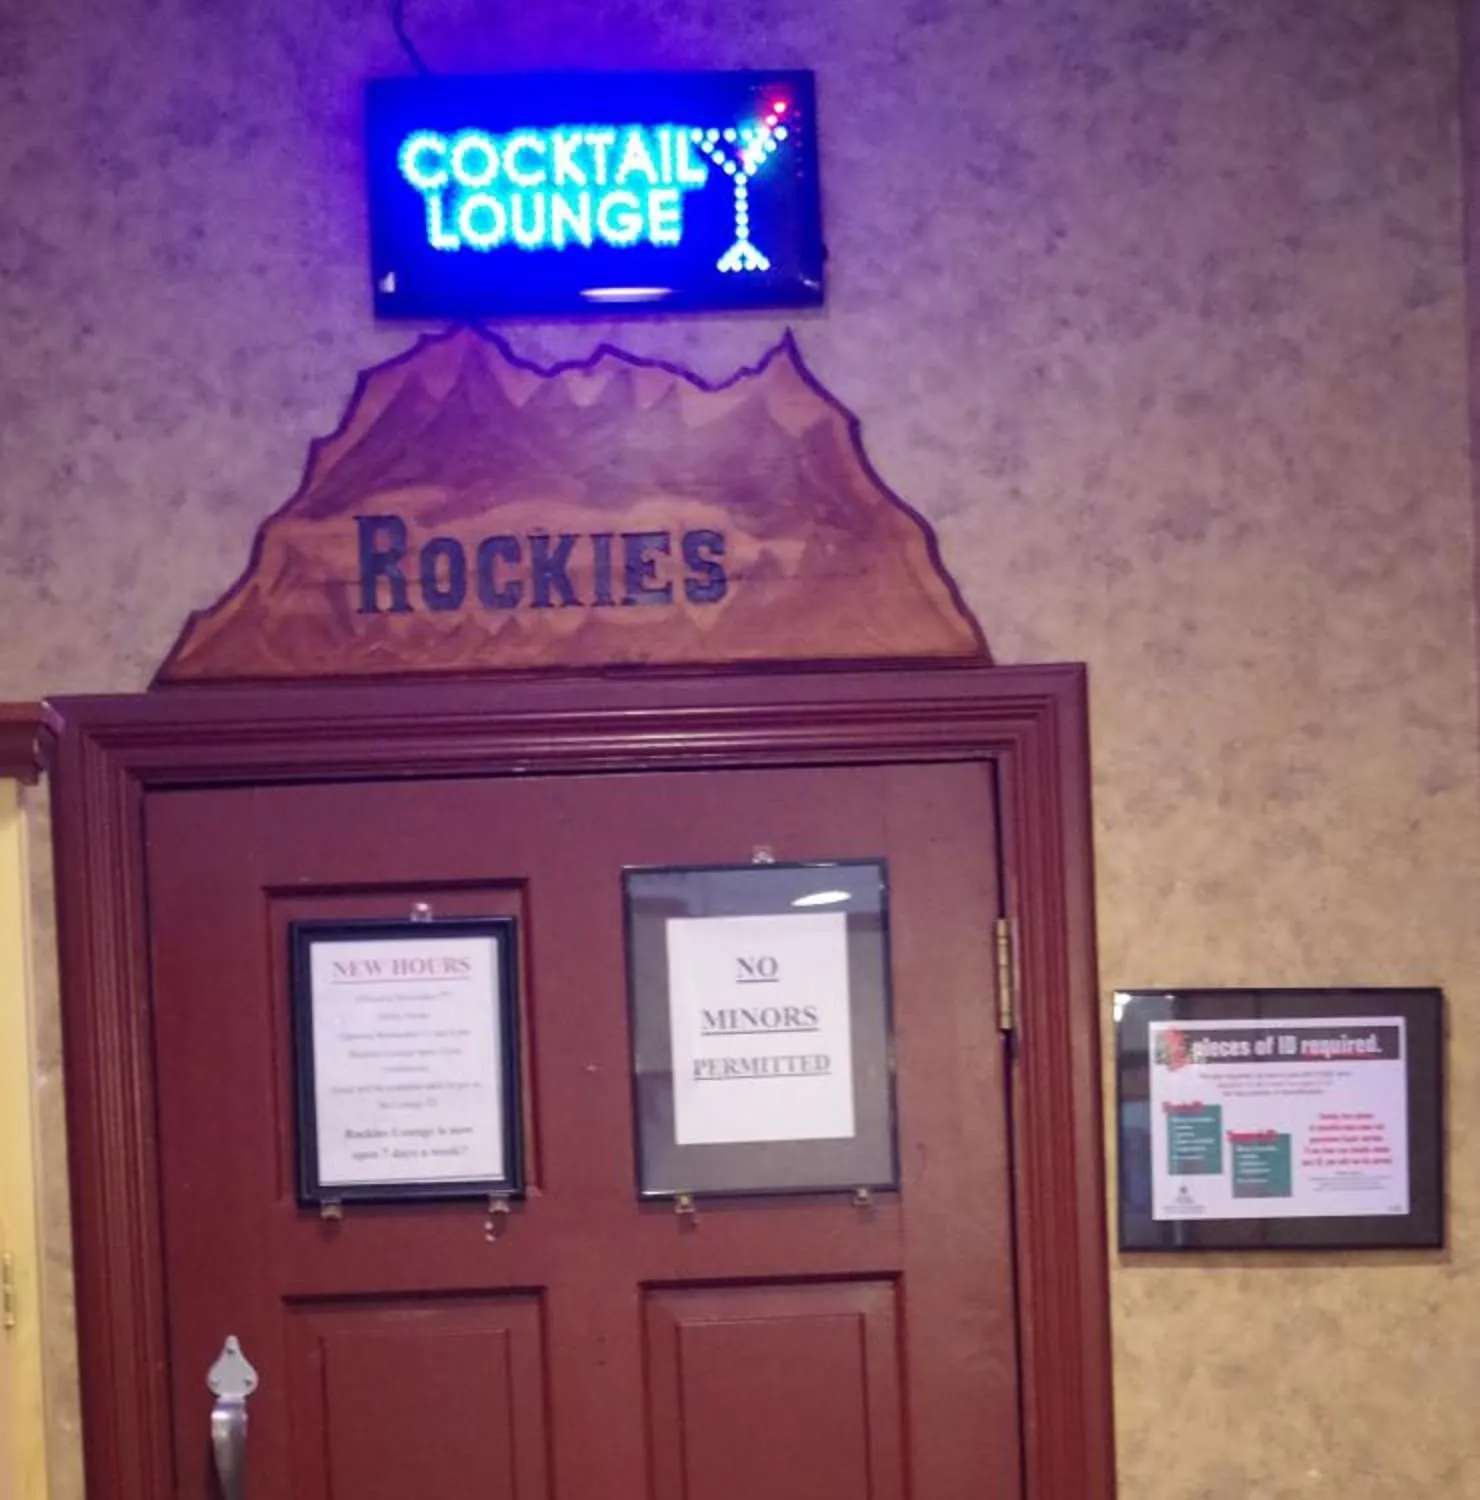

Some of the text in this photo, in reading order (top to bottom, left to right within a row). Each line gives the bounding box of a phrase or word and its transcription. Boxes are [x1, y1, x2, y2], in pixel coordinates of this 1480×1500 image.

[400, 126, 708, 190] COCKTAIL
[425, 188, 683, 250] LOUNGE
[332, 956, 472, 978] NEW HOURS
[736, 956, 779, 980] NO
[701, 1005, 819, 1032] MINORS
[1192, 1037, 1251, 1062] pieces
[1254, 1035, 1275, 1055] of
[692, 1054, 831, 1078] PERMITTED
